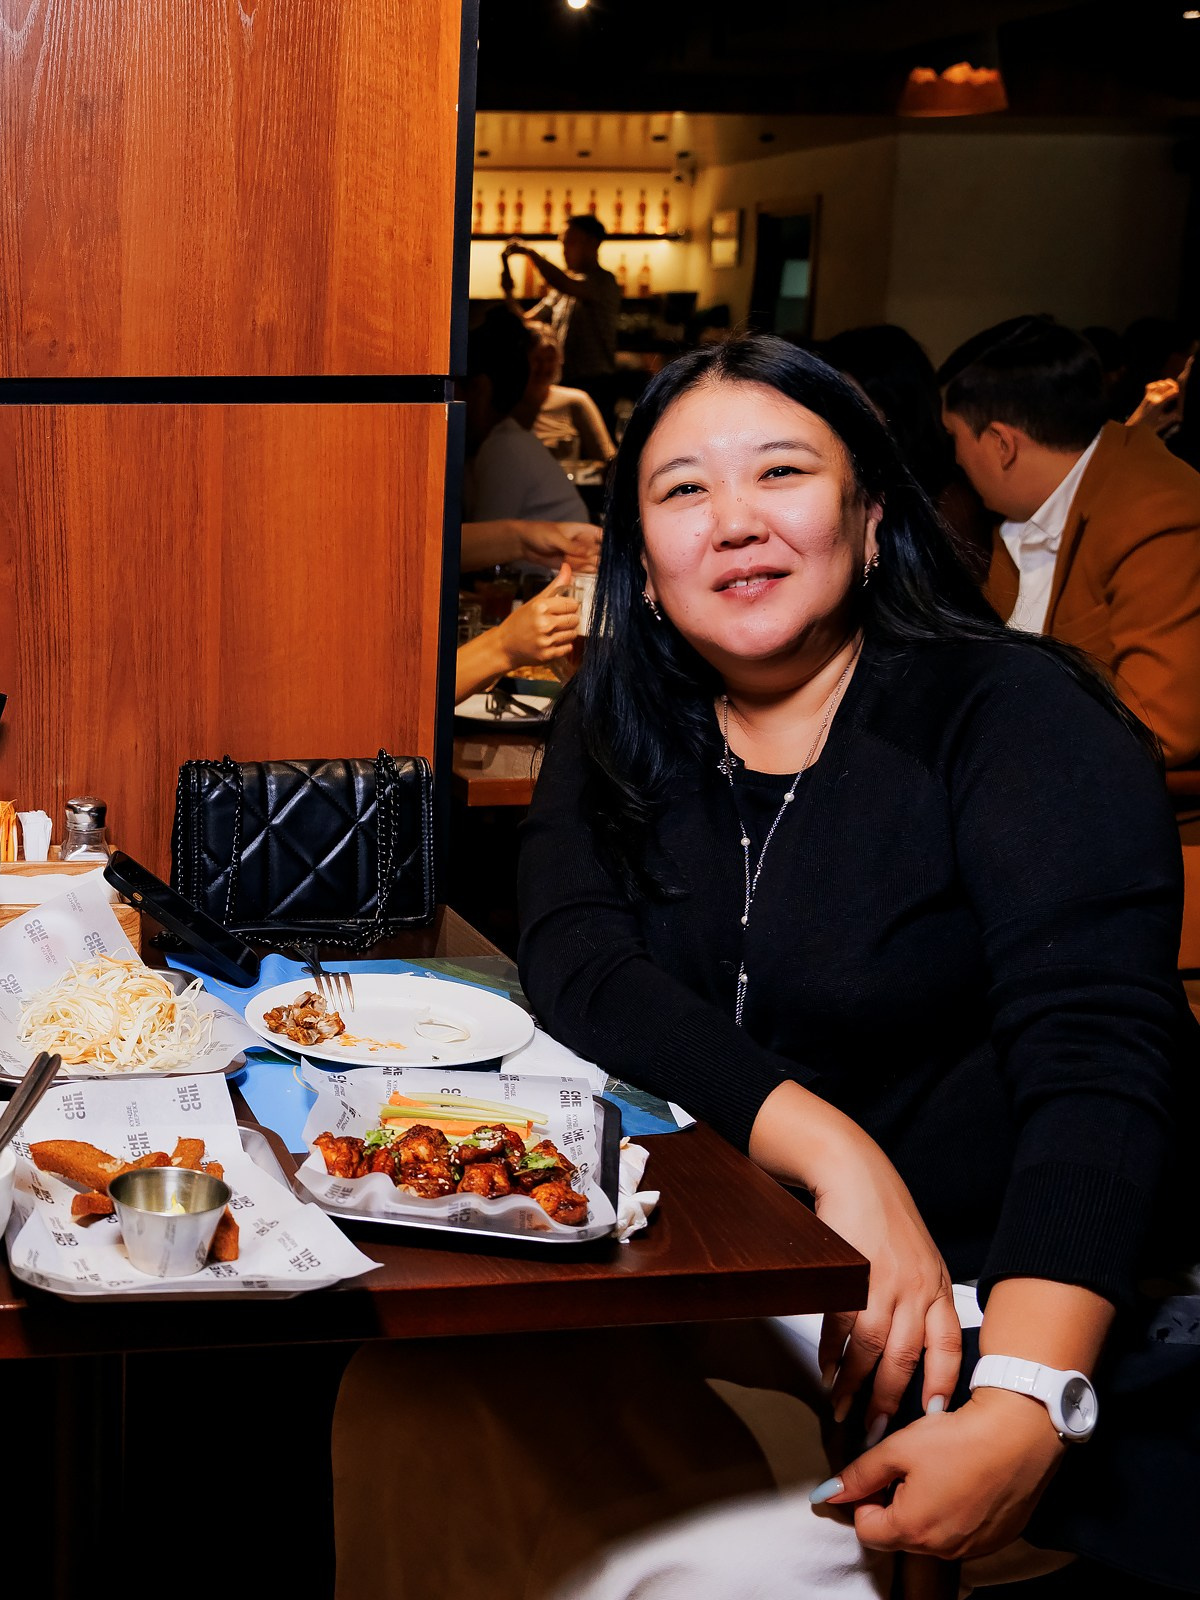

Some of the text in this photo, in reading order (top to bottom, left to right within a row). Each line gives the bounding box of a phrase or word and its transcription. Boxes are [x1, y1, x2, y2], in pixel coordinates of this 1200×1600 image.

[62, 1094, 76, 1120] CHE
[73, 1091, 86, 1120] CHIL
[177, 1086, 191, 1111] CHE
[188, 1083, 202, 1111] CHIL
[560, 1090, 571, 1109] CHIL
[571, 1090, 582, 1108] CHE
[127, 1134, 142, 1158] CHE
[578, 1162, 590, 1178] CH
[289, 1255, 310, 1273] CHE
[301, 1248, 321, 1268] CHIL
